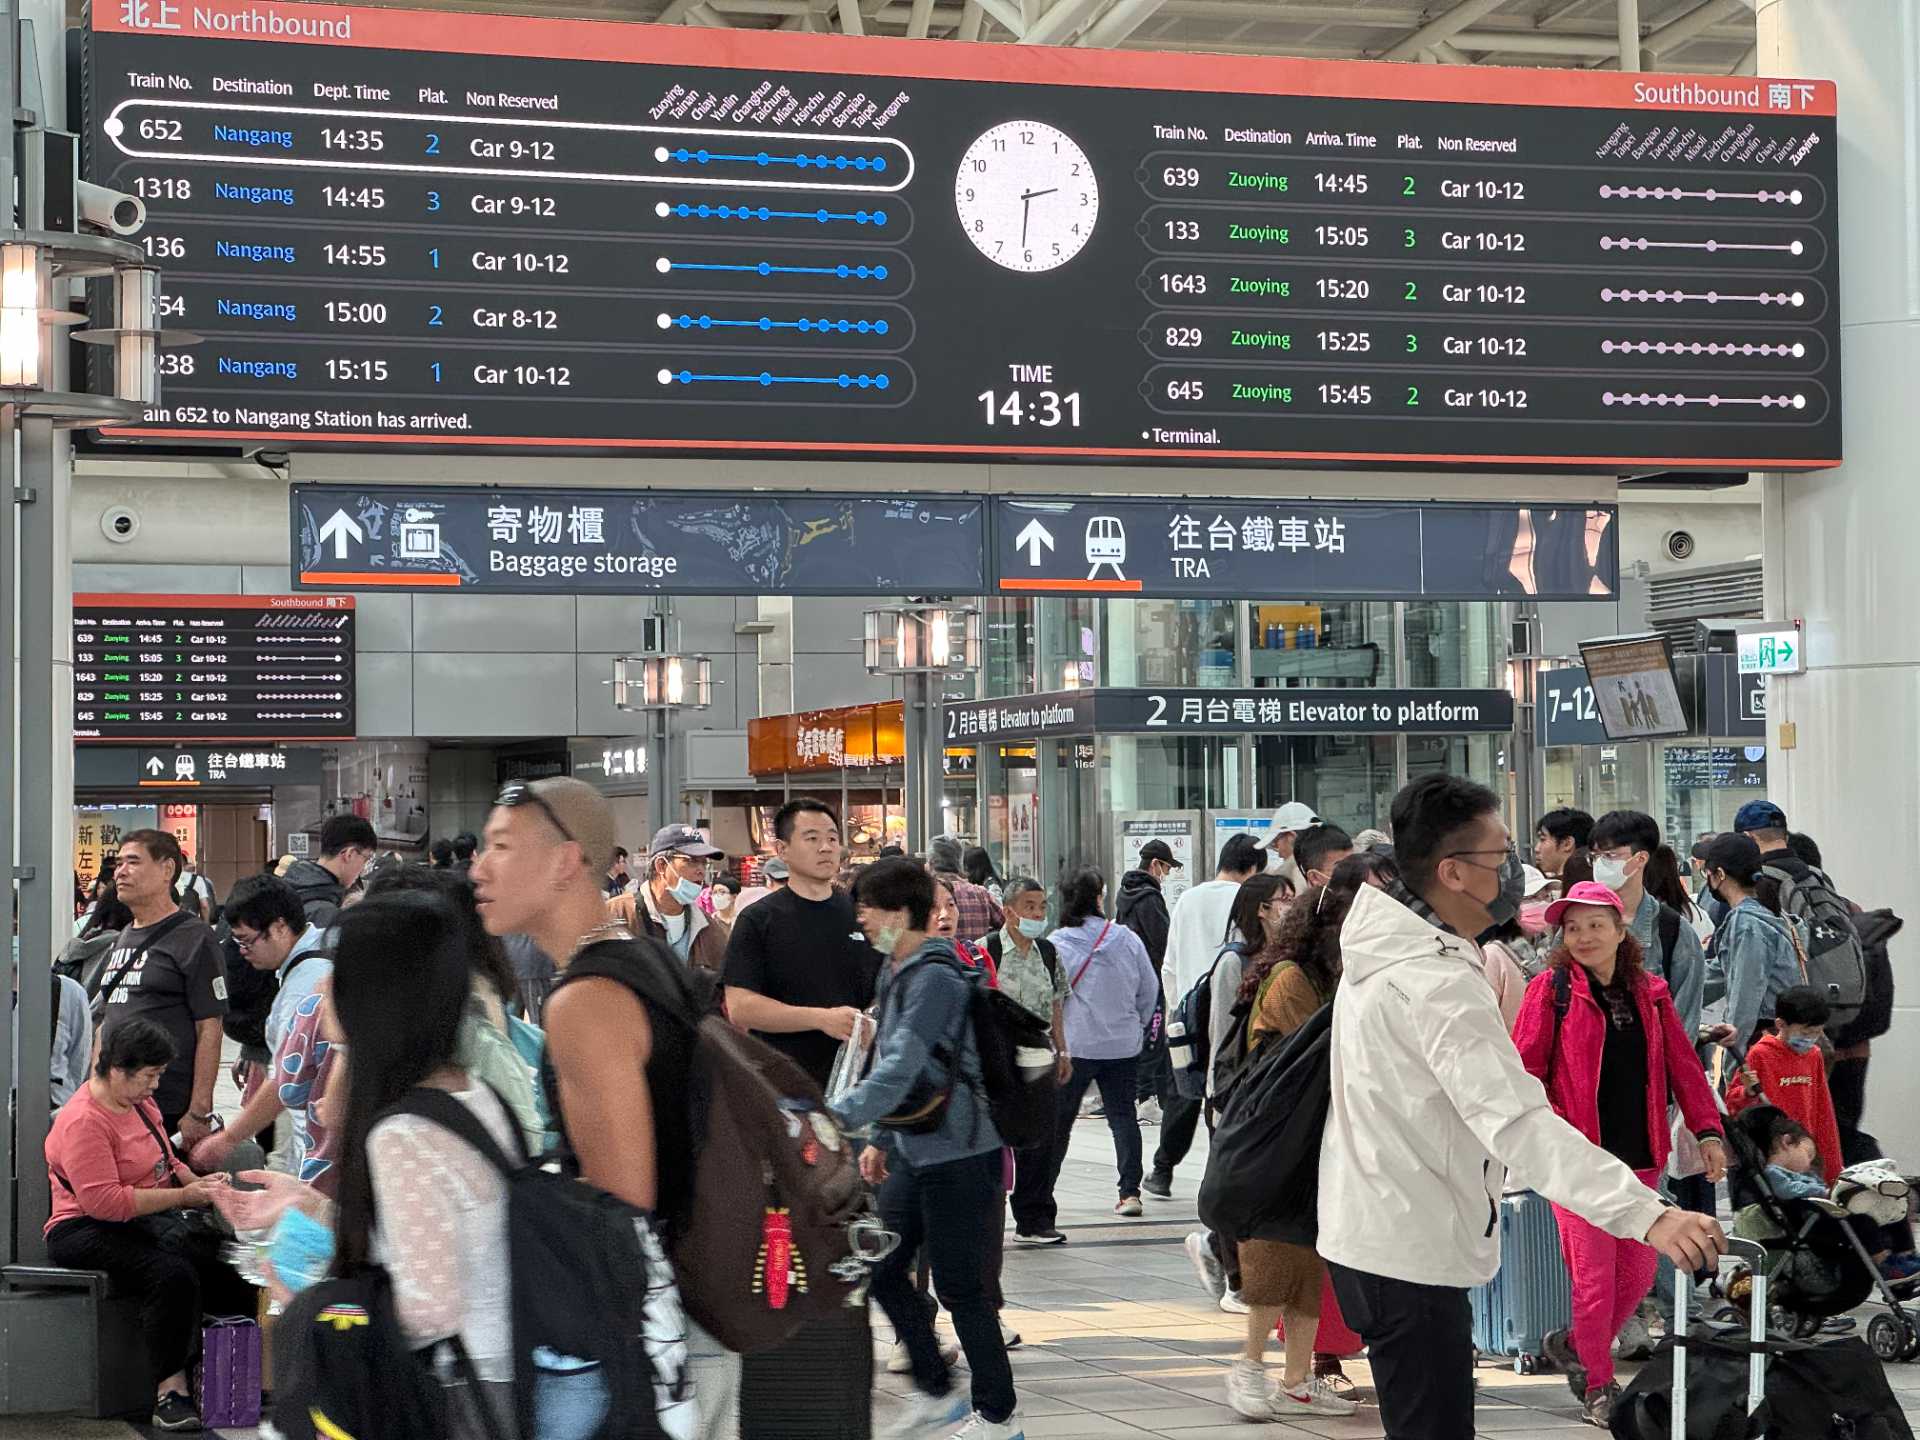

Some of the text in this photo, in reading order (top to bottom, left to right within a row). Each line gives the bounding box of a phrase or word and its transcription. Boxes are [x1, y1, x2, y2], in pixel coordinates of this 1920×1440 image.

[120, 0, 181, 29] 北上
[194, 4, 350, 39] Northbound
[128, 73, 192, 89] Train No.
[213, 78, 292, 95] Destination
[314, 83, 390, 100] Dept. Time
[419, 88, 448, 103] Plat.
[467, 92, 557, 109] Non Reserved
[1635, 83, 1814, 109] Southbound 南下
[649, 84, 685, 121] Zuoying
[669, 89, 699, 121] Tainan
[691, 95, 718, 122] Chiayi
[710, 94, 739, 123] Yunlin
[731, 80, 772, 123] Changhua
[751, 85, 790, 125] Taichung
[772, 96, 799, 126] Miaoli
[792, 91, 825, 127] Hsinchu
[811, 91, 847, 128] Taoyuan
[832, 93, 866, 129] Banqiao
[873, 91, 911, 131] Nangang
[851, 102, 878, 130] Taipei
[140, 119, 182, 140] 652
[215, 126, 292, 148] Nangang
[1018, 131, 1035, 145] 12
[1153, 125, 1209, 141] Train No.
[1225, 129, 1291, 144] Destination
[1306, 131, 1376, 147] Arriva. Time
[321, 129, 383, 150] 14:35
[425, 133, 440, 154] 2
[991, 138, 1006, 152] 11
[1052, 141, 1058, 155] 1
[1398, 134, 1422, 149] Plat.
[1437, 136, 1516, 152] Non Reserved
[470, 139, 554, 160] Car 9-12
[971, 159, 987, 173] 10
[1071, 163, 1080, 177] 2
[1164, 168, 1199, 186] 639
[1229, 172, 1288, 191] Zuoying
[1315, 173, 1367, 193] 14:45
[1403, 176, 1416, 195] 2
[133, 178, 192, 201] 1318
[216, 183, 293, 205] Nangang
[323, 187, 384, 208] 14:45
[965, 188, 975, 202] 9
[1441, 180, 1524, 199] Car 10-12
[427, 191, 440, 211] 3
[471, 195, 555, 216] Car 9-12
[1079, 192, 1089, 207] 3
[974, 219, 984, 233] 8
[1071, 223, 1079, 236] 4
[1165, 221, 1199, 240] 133
[1230, 225, 1288, 243] Zuoying
[1315, 227, 1368, 246] 15:05
[1404, 229, 1416, 248] 3
[1442, 232, 1524, 251] Car 10-12
[142, 236, 185, 261] 136
[217, 241, 295, 262] Nangang
[324, 245, 385, 265] 14:55
[994, 240, 1004, 254] 7
[1023, 249, 1033, 263] 6
[1052, 242, 1060, 257] 5
[429, 248, 439, 269] 1
[472, 252, 568, 272] Car 10-12
[1160, 274, 1206, 293] 1643
[1231, 278, 1289, 296] Zuoying
[1317, 279, 1369, 298] 15:20
[1404, 281, 1417, 300] 2
[1443, 285, 1525, 303] Car 10-12
[151, 294, 186, 319] 54
[218, 300, 296, 320] Nangang
[325, 302, 386, 323] 15:00
[428, 305, 443, 326] 2
[473, 309, 557, 328] Car 8-12
[1167, 328, 1201, 346] 829
[1232, 331, 1290, 349] Zuoying
[1317, 332, 1370, 351] 15:25
[1406, 334, 1418, 353] 3
[1444, 337, 1526, 355] Car 10-12
[220, 358, 296, 378] Nangang
[326, 360, 387, 380] 15:15
[430, 362, 441, 383] 1
[474, 366, 570, 385] Car 10-12
[1009, 365, 1052, 382] TIME
[1168, 381, 1203, 400] 645
[1233, 384, 1291, 402] Zuoying
[1319, 385, 1371, 404] 15:45
[1406, 386, 1419, 406] 2
[1445, 389, 1527, 407] Car 10-12
[144, 407, 471, 429] ain 652 to Nangang Station has arrived.
[978, 391, 1079, 426] 14:31
[1152, 428, 1220, 443] Terminal.
[488, 505, 605, 544] 寄物櫃
[1169, 514, 1345, 553] 往台鐵車站
[490, 550, 676, 577] Baggage storage
[1171, 558, 1210, 578] TRA
[271, 597, 324, 607] Southbound
[76, 633, 95, 643] 639
[77, 652, 94, 663] 133
[75, 672, 97, 682] 1643
[77, 692, 95, 702] 829
[77, 711, 95, 721] 645
[947, 702, 1074, 739] 2 月台電梯 Elevator to platform
[1147, 696, 1478, 726] 2 月台電梯 Elevator to platform
[207, 769, 227, 780] TRA
